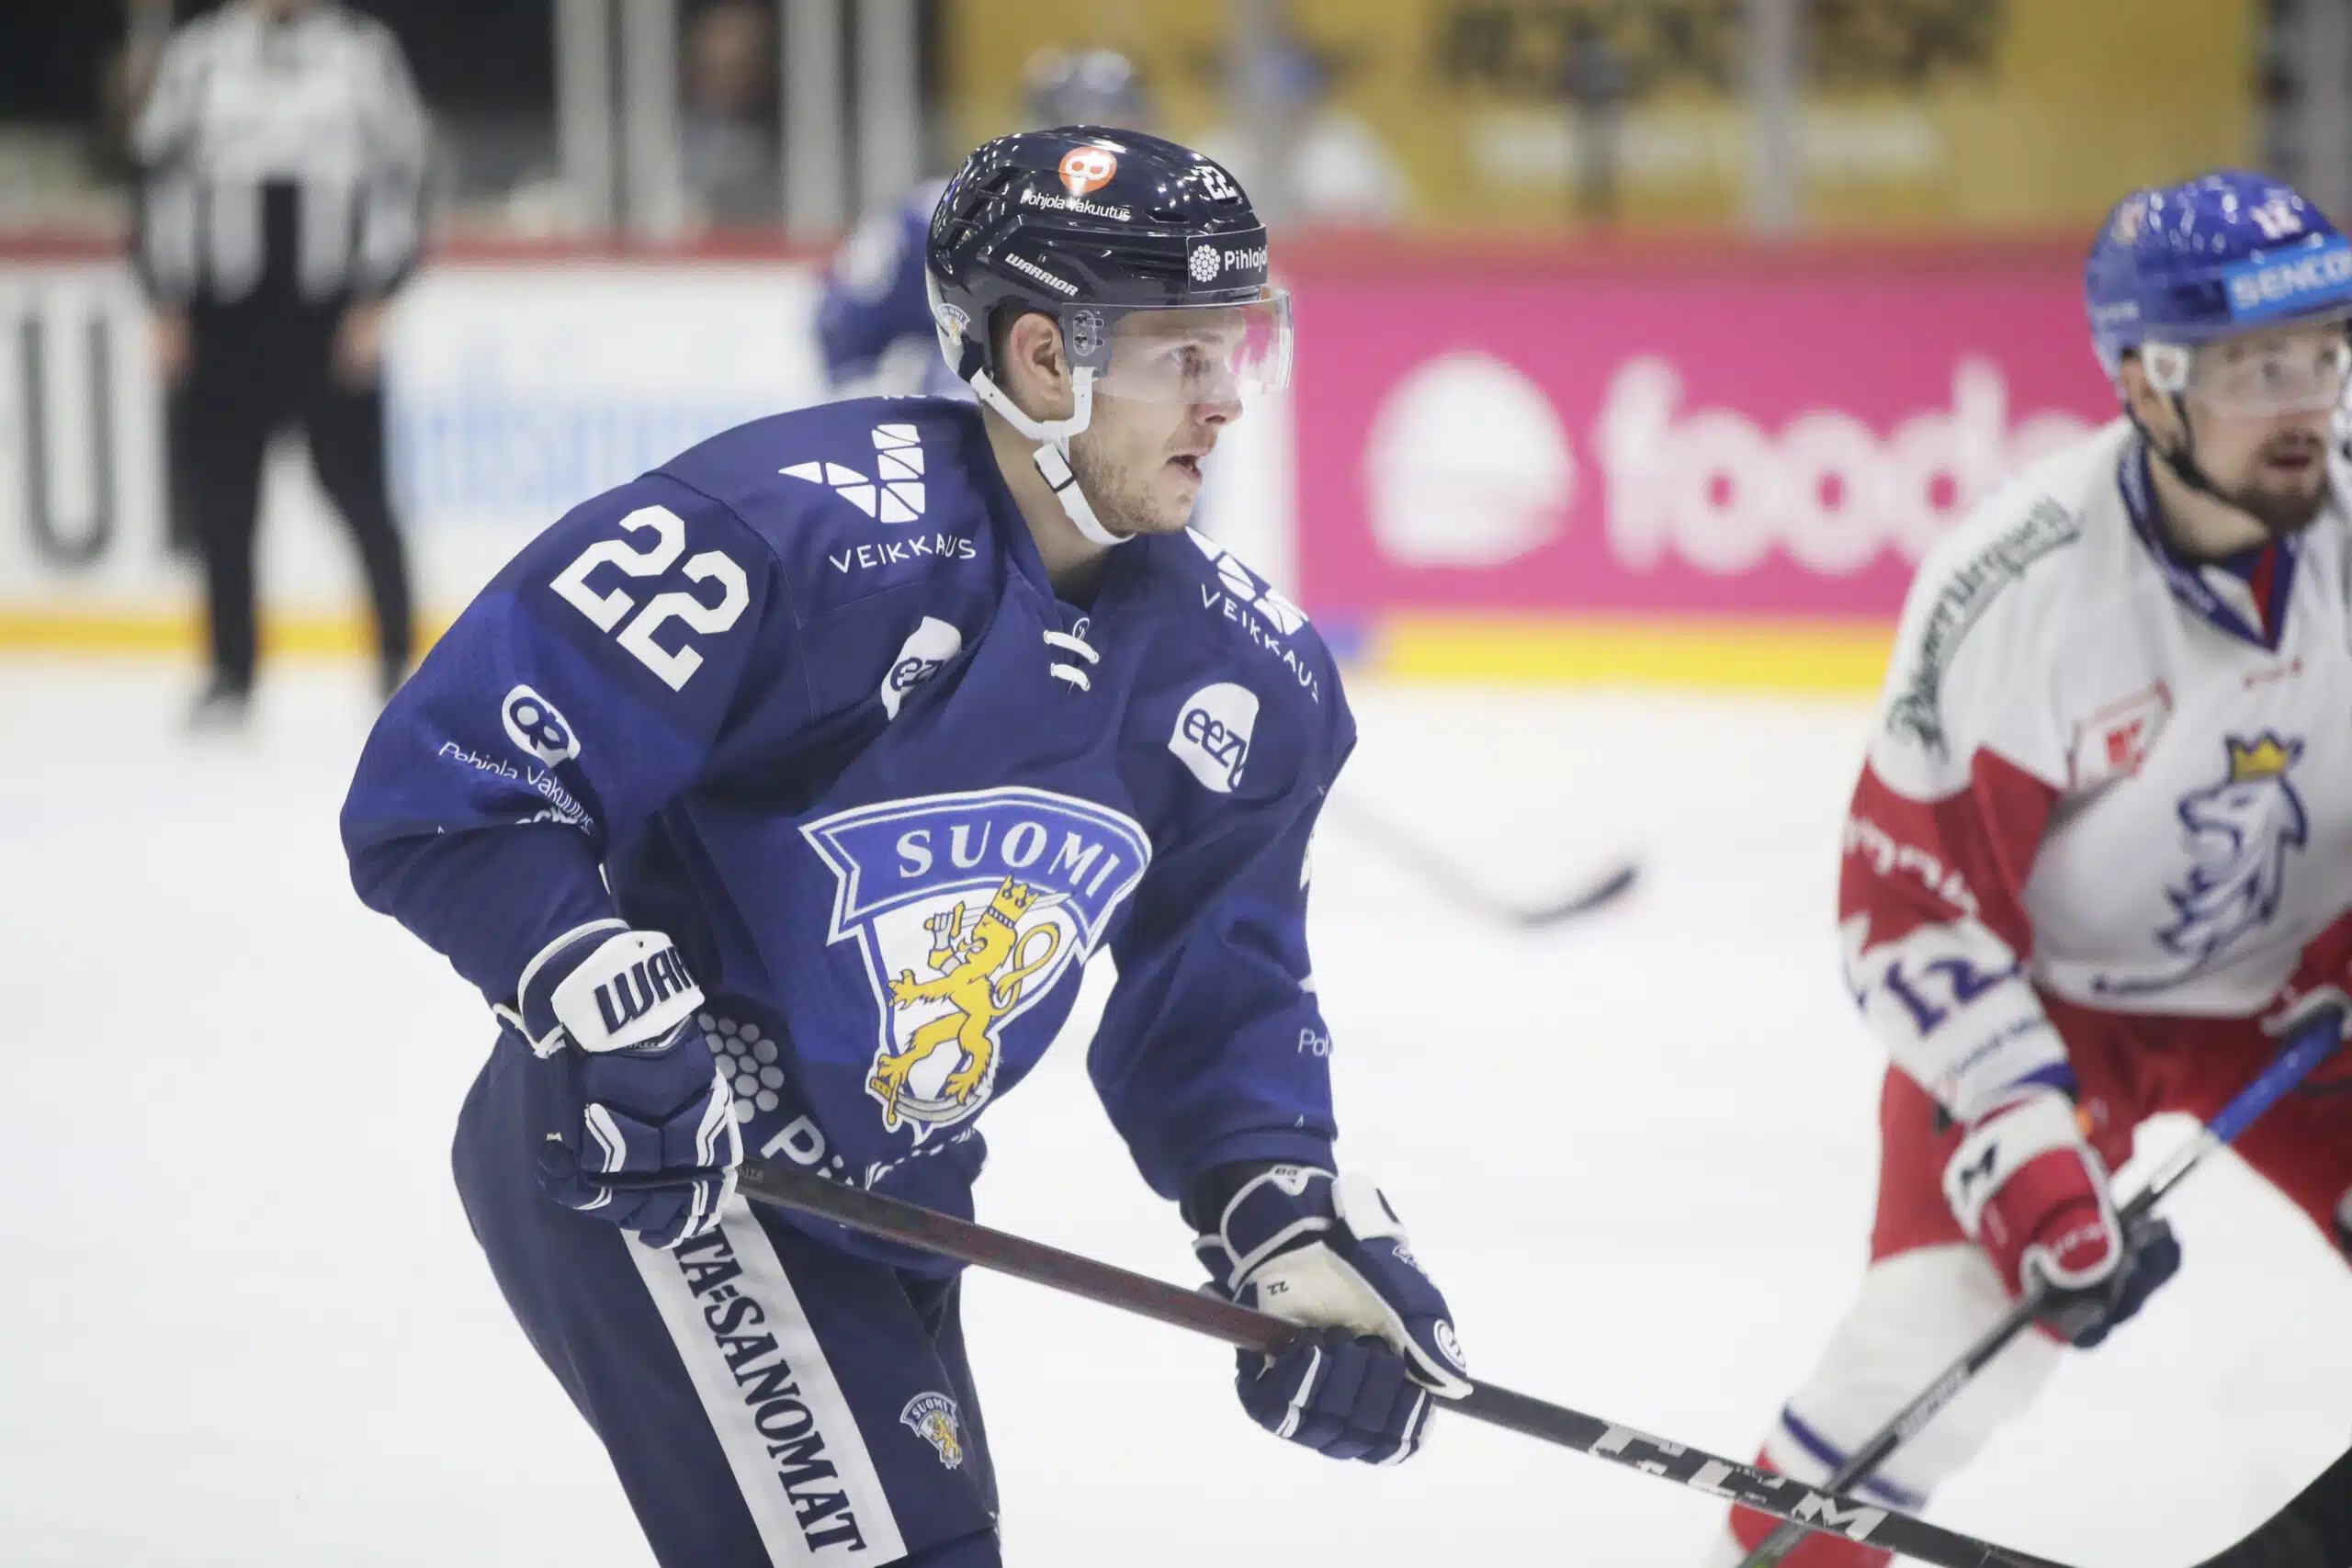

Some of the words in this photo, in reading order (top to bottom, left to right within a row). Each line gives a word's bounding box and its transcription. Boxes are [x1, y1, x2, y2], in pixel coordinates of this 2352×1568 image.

[1192, 165, 1238, 200] 22
[1020, 188, 1066, 210] Pohjola
[1066, 197, 1131, 222] Vakuutus
[1004, 252, 1079, 297] WARRIOR
[1597, 354, 2100, 574] food
[829, 533, 977, 573] VEIKKAUS
[549, 504, 749, 693] 22
[897, 820, 1120, 897] SUOMI
[911, 1398, 948, 1420] SUOMI
